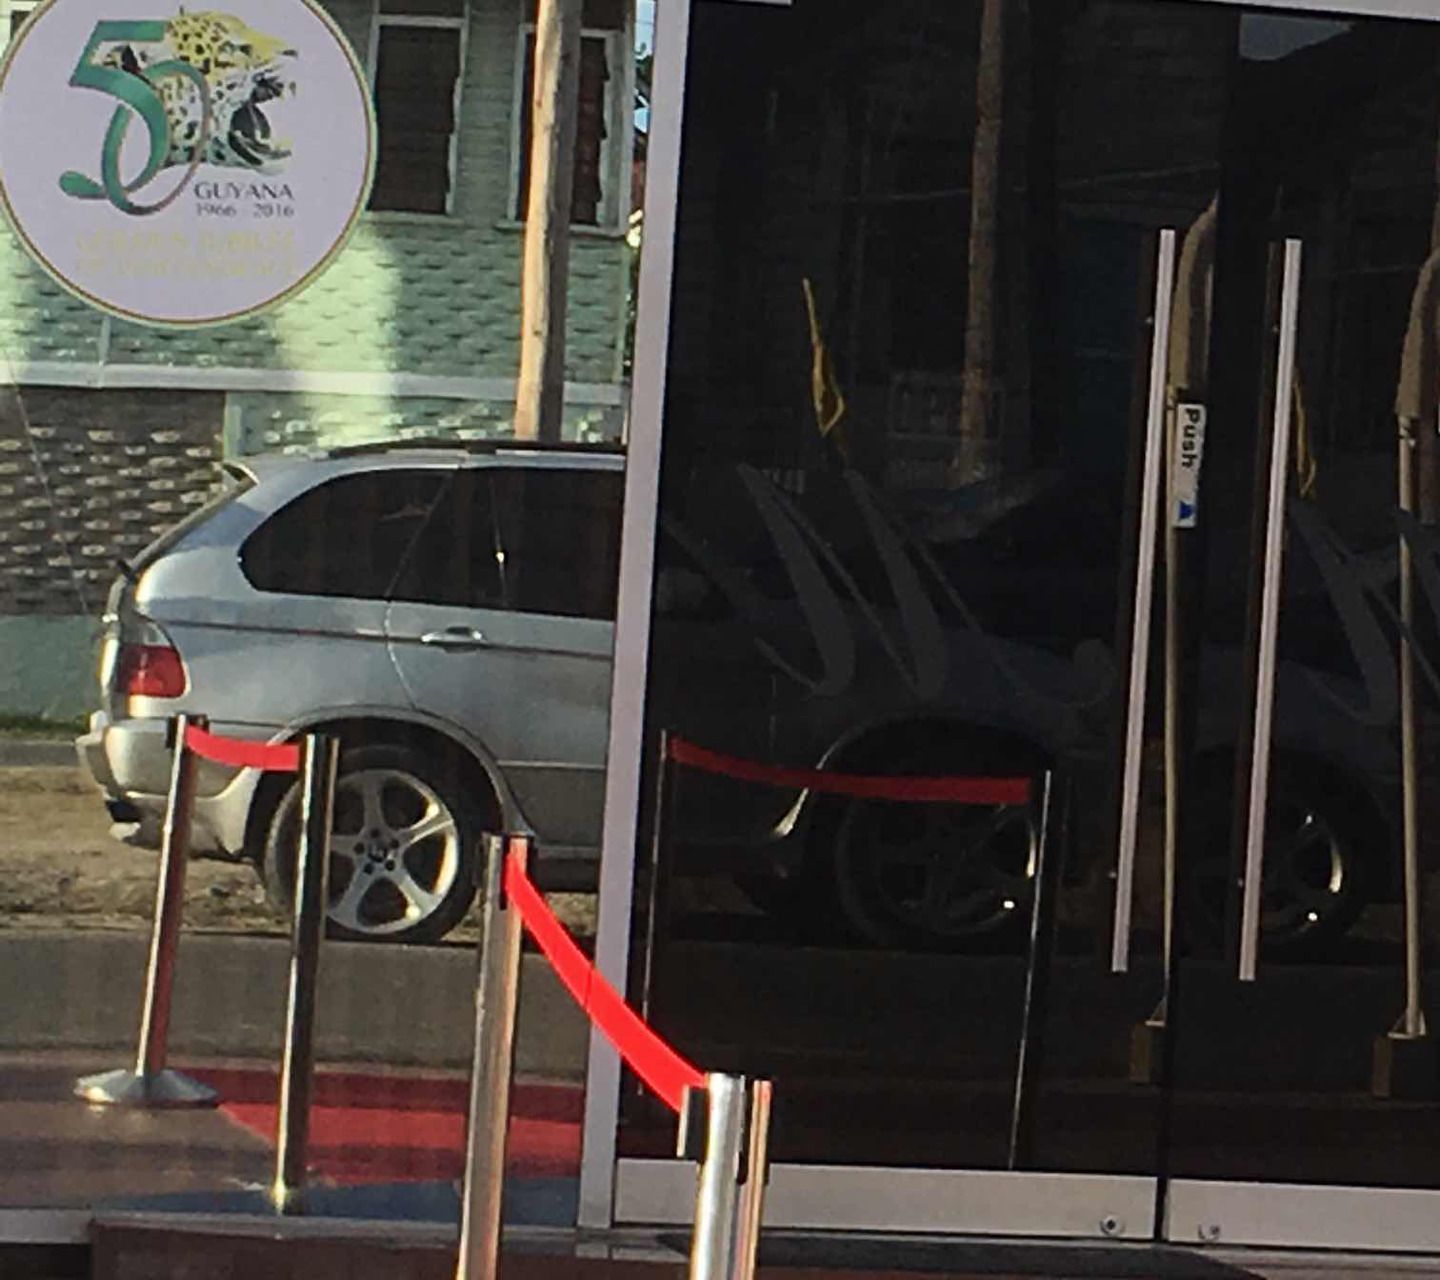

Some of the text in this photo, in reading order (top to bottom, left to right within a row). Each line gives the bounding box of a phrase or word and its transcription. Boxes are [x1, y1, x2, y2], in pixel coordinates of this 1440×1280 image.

[59, 20, 210, 216] 50
[194, 181, 295, 201] GUYANA
[196, 202, 295, 219] 1966 2016
[1182, 407, 1200, 469] Push
